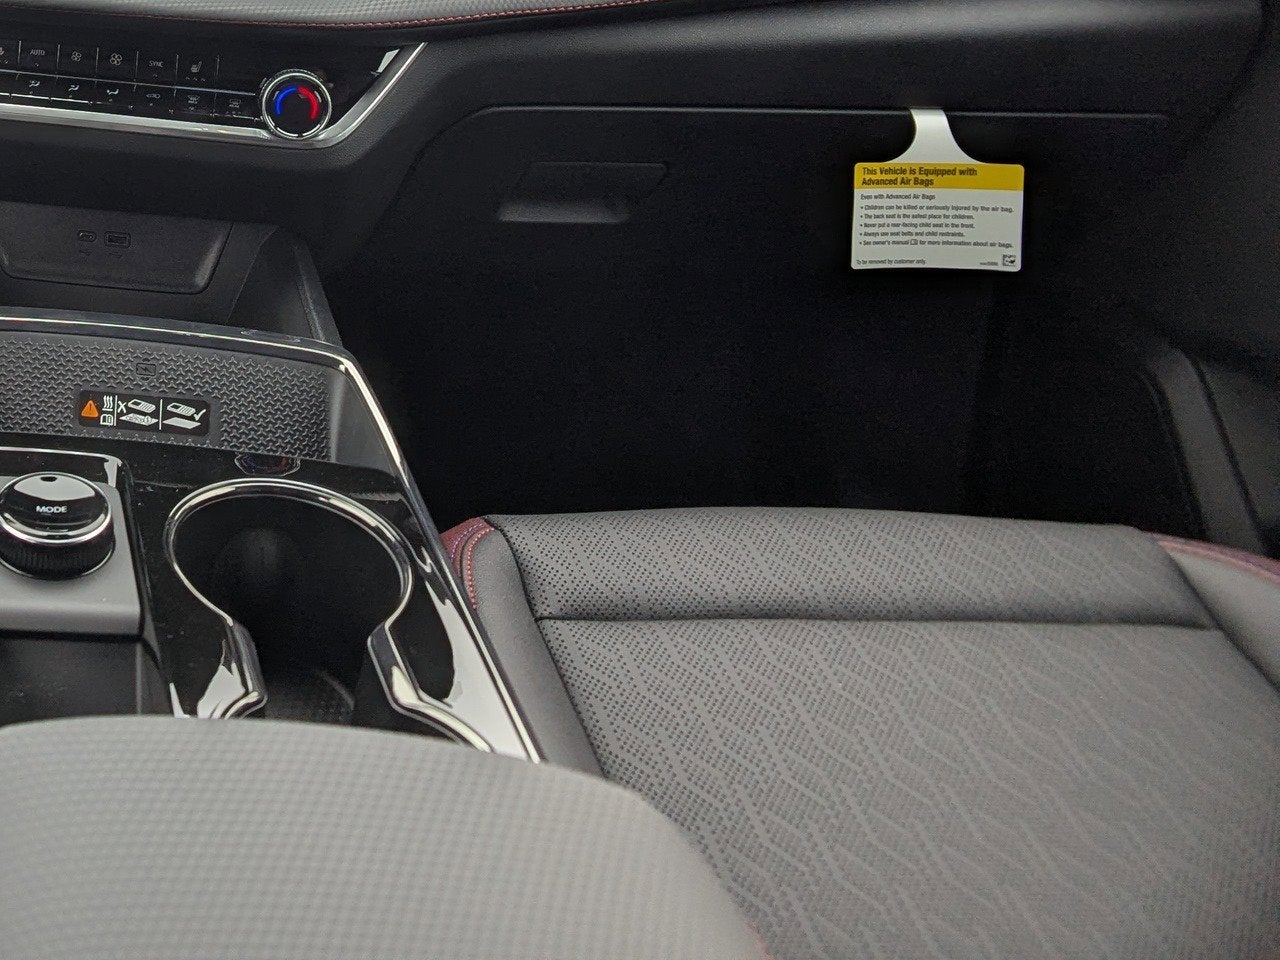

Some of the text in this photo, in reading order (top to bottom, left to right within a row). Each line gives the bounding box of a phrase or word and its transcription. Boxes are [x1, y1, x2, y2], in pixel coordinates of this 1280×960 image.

[148, 60, 164, 68] SYNC
[862, 167, 977, 177] This Vehicle is Equipped with
[862, 177, 934, 187] Advanced Air Bags
[922, 193, 936, 201] Bags
[35, 505, 68, 513] MODE
